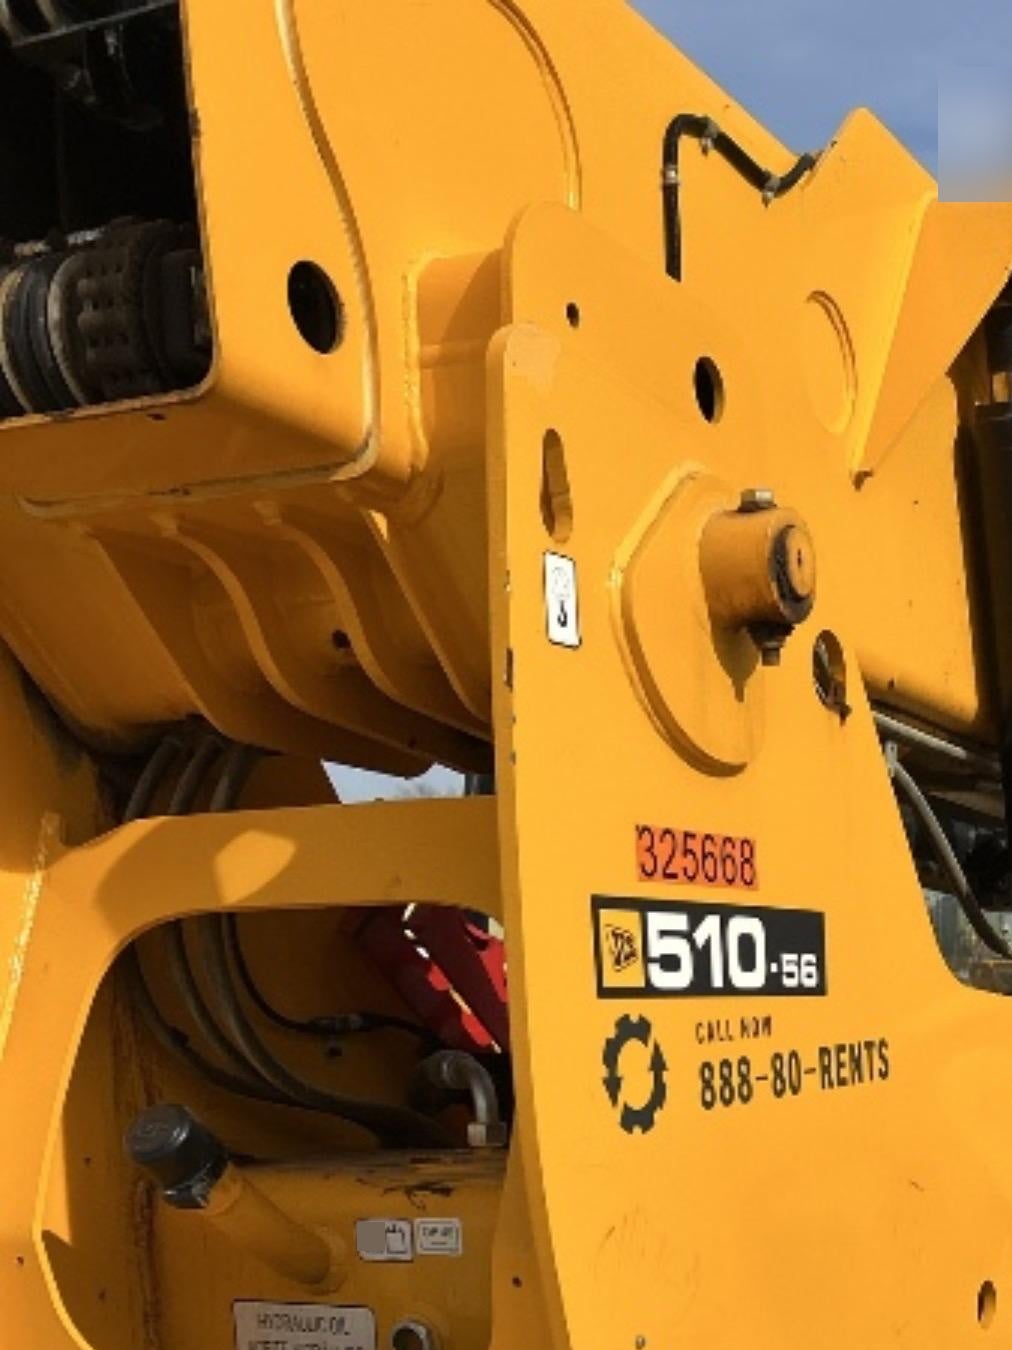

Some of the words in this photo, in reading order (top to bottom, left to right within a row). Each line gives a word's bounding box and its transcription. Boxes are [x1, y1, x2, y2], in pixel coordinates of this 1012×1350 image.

[637, 824, 755, 887] 325668
[695, 1018, 733, 1045] CALL
[740, 1014, 772, 1039] NOW
[699, 1037, 890, 1110] 888-80-RENTS
